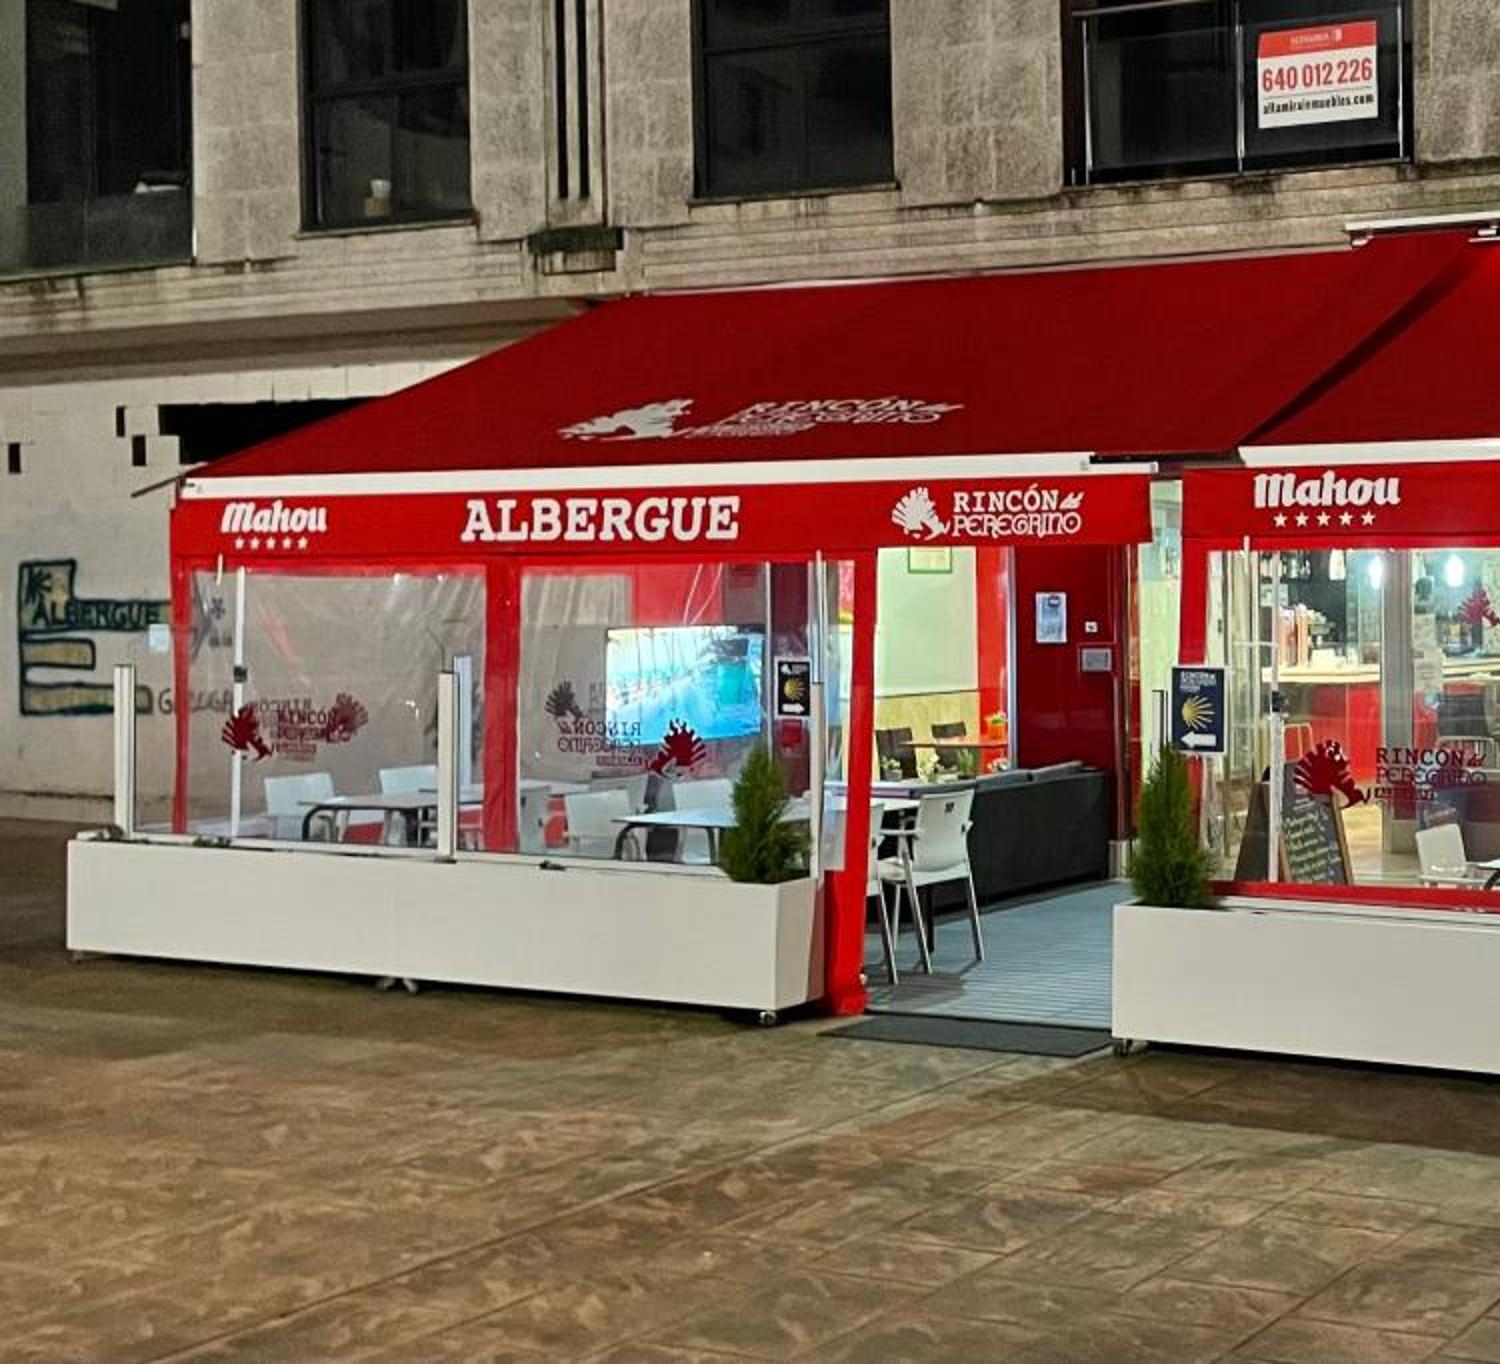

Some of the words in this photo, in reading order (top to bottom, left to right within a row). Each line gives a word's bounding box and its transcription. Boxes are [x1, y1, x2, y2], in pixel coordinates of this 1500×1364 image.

[1262, 66, 1297, 92] 640
[1302, 62, 1333, 87] 012
[1337, 58, 1373, 83] 226
[953, 483, 1059, 513] RINCÓN
[1253, 469, 1402, 509] Mahou
[220, 500, 327, 534] Mahou
[461, 496, 741, 542] ALBERGUE
[951, 511, 1083, 539] PEREGRINO
[31, 601, 160, 626] ALBERGUE
